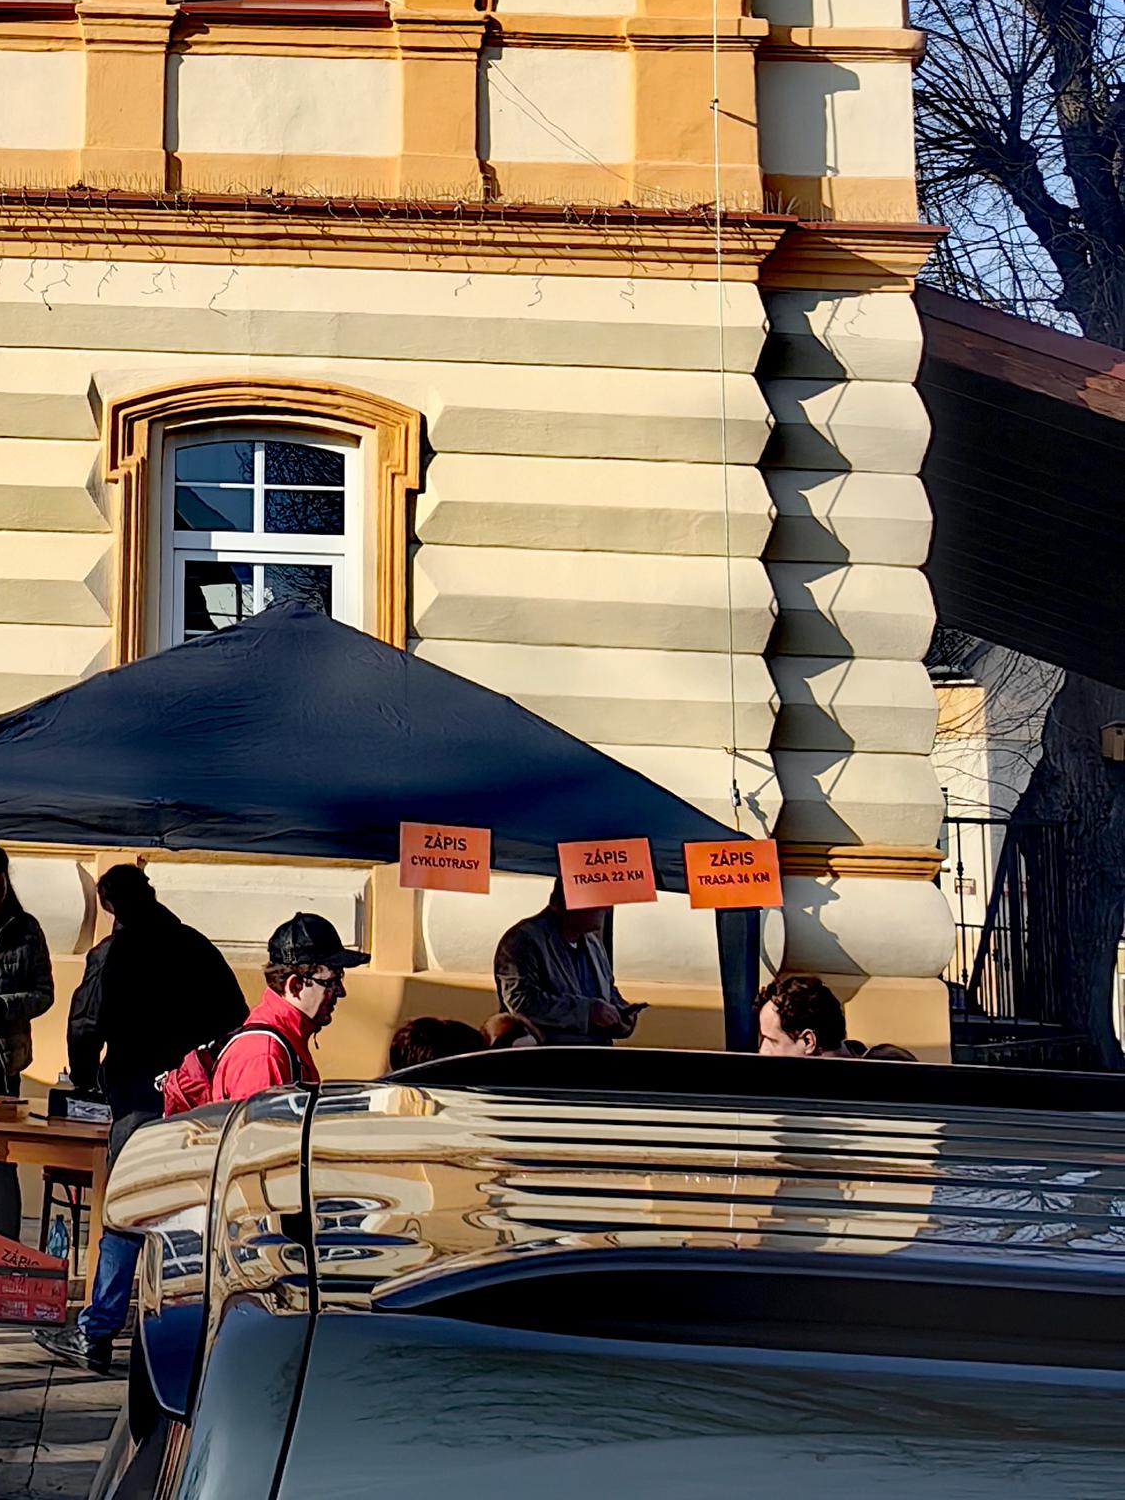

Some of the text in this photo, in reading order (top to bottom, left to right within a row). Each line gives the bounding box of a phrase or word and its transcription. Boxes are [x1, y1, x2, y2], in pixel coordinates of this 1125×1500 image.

[424, 831, 467, 851] ZÁPIS
[411, 854, 480, 870] CYKLOTRASY
[583, 847, 628, 866] ZÁPIS
[709, 848, 755, 867] ZÁPIS
[572, 869, 644, 885] TRASA 22 KM
[697, 871, 770, 886] TRASA 36 KM
